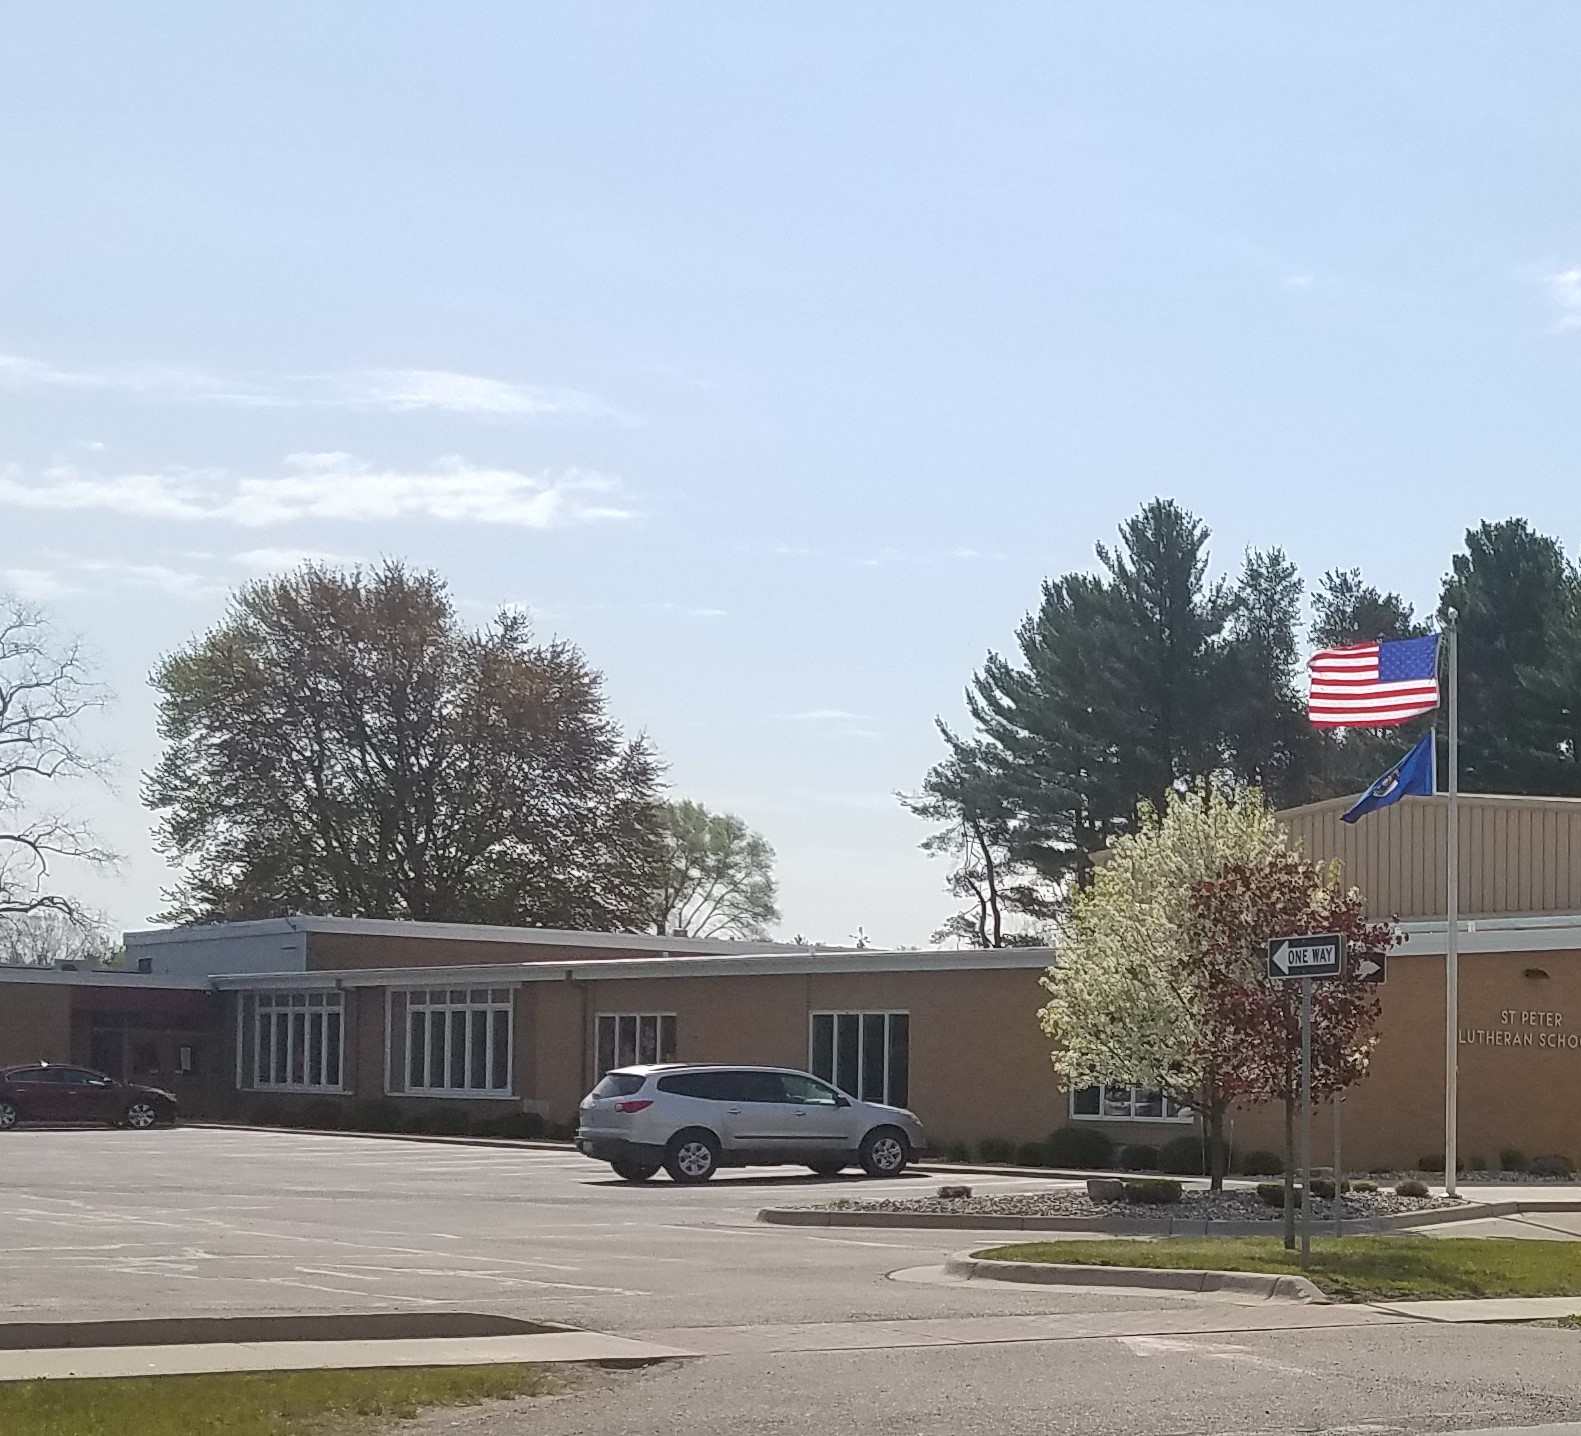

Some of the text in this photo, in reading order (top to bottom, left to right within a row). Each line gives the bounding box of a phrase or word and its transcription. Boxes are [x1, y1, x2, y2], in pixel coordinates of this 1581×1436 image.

[1288, 947, 1333, 965] ONE WAY
[1501, 1010, 1562, 1027] ST PETER
[1458, 1029, 1533, 1047] LUTHERAN
